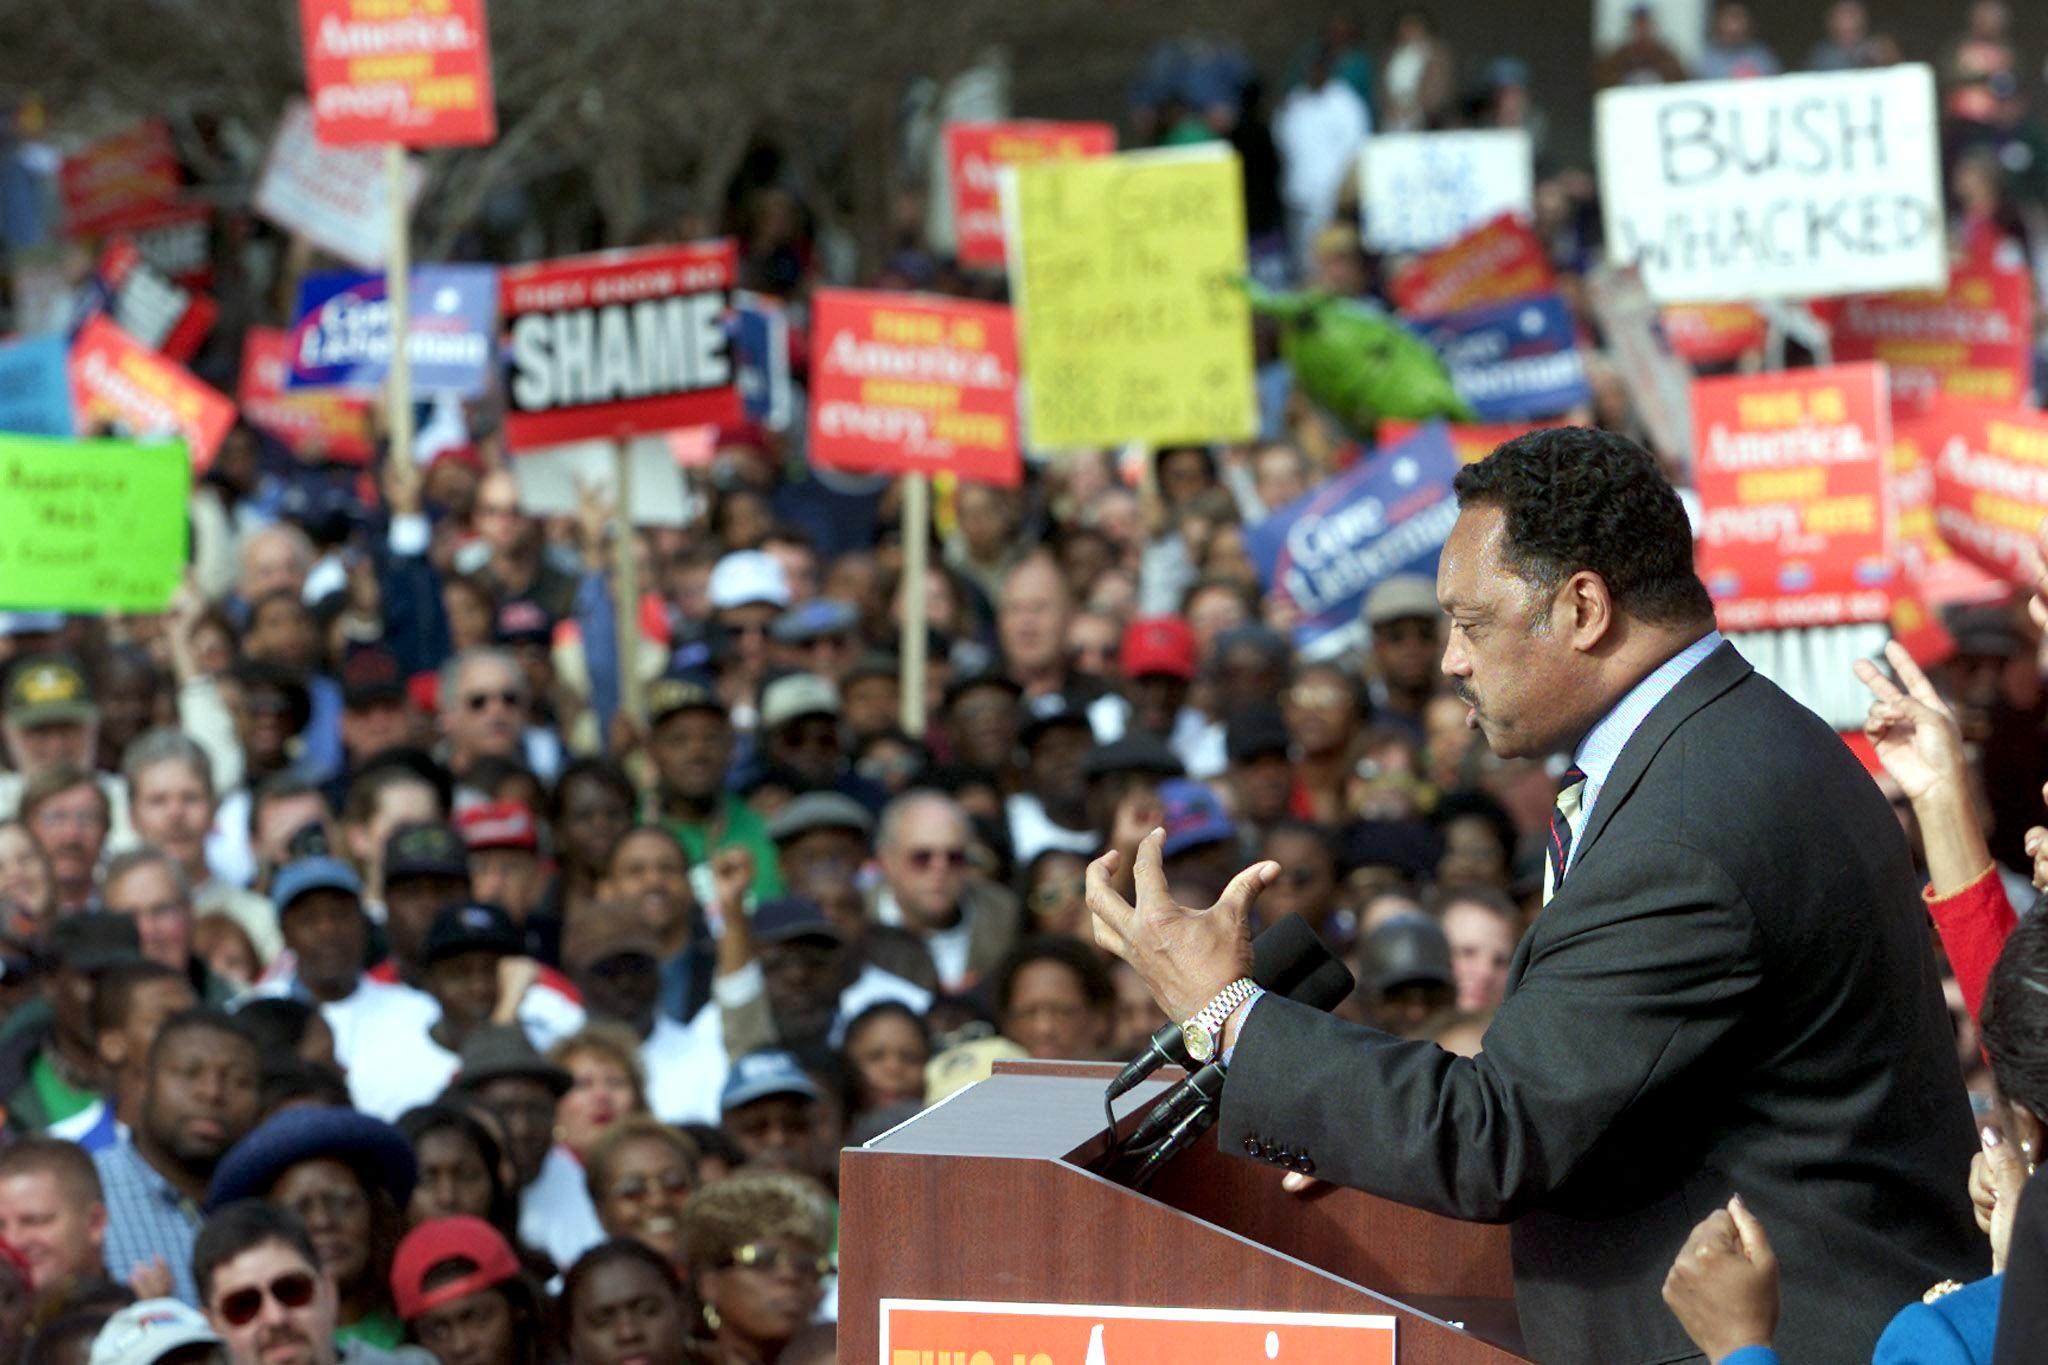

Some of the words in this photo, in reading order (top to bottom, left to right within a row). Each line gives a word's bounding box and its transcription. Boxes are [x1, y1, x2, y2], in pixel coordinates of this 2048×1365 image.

[1656, 96, 1888, 188] BUSH
[1618, 196, 1931, 270] WHACKED
[511, 290, 732, 413] SHAME
